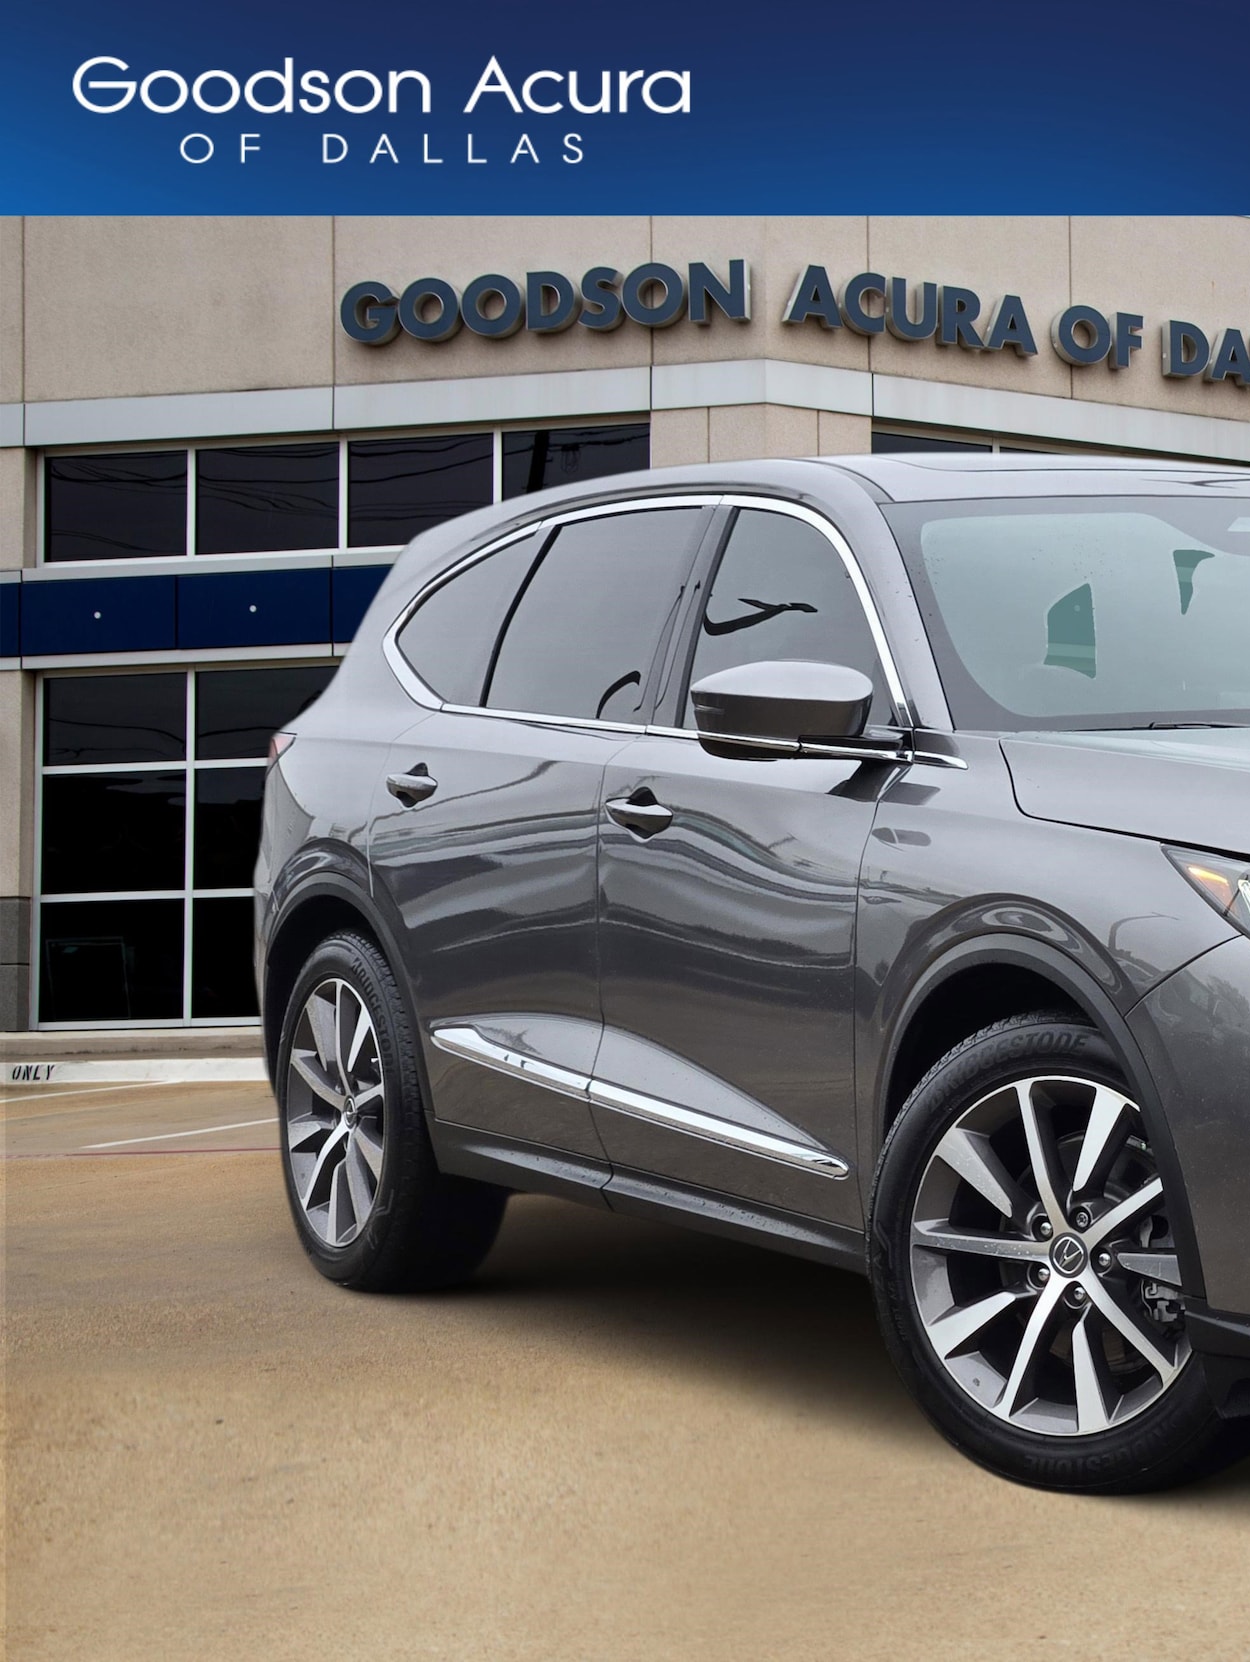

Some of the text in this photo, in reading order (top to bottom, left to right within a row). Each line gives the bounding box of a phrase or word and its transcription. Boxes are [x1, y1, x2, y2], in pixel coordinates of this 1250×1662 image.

[340, 259, 751, 345] GOODSON
[782, 264, 1038, 356] ACURA
[1051, 304, 1144, 370] OF
[12, 1065, 55, 1081] ONLY
